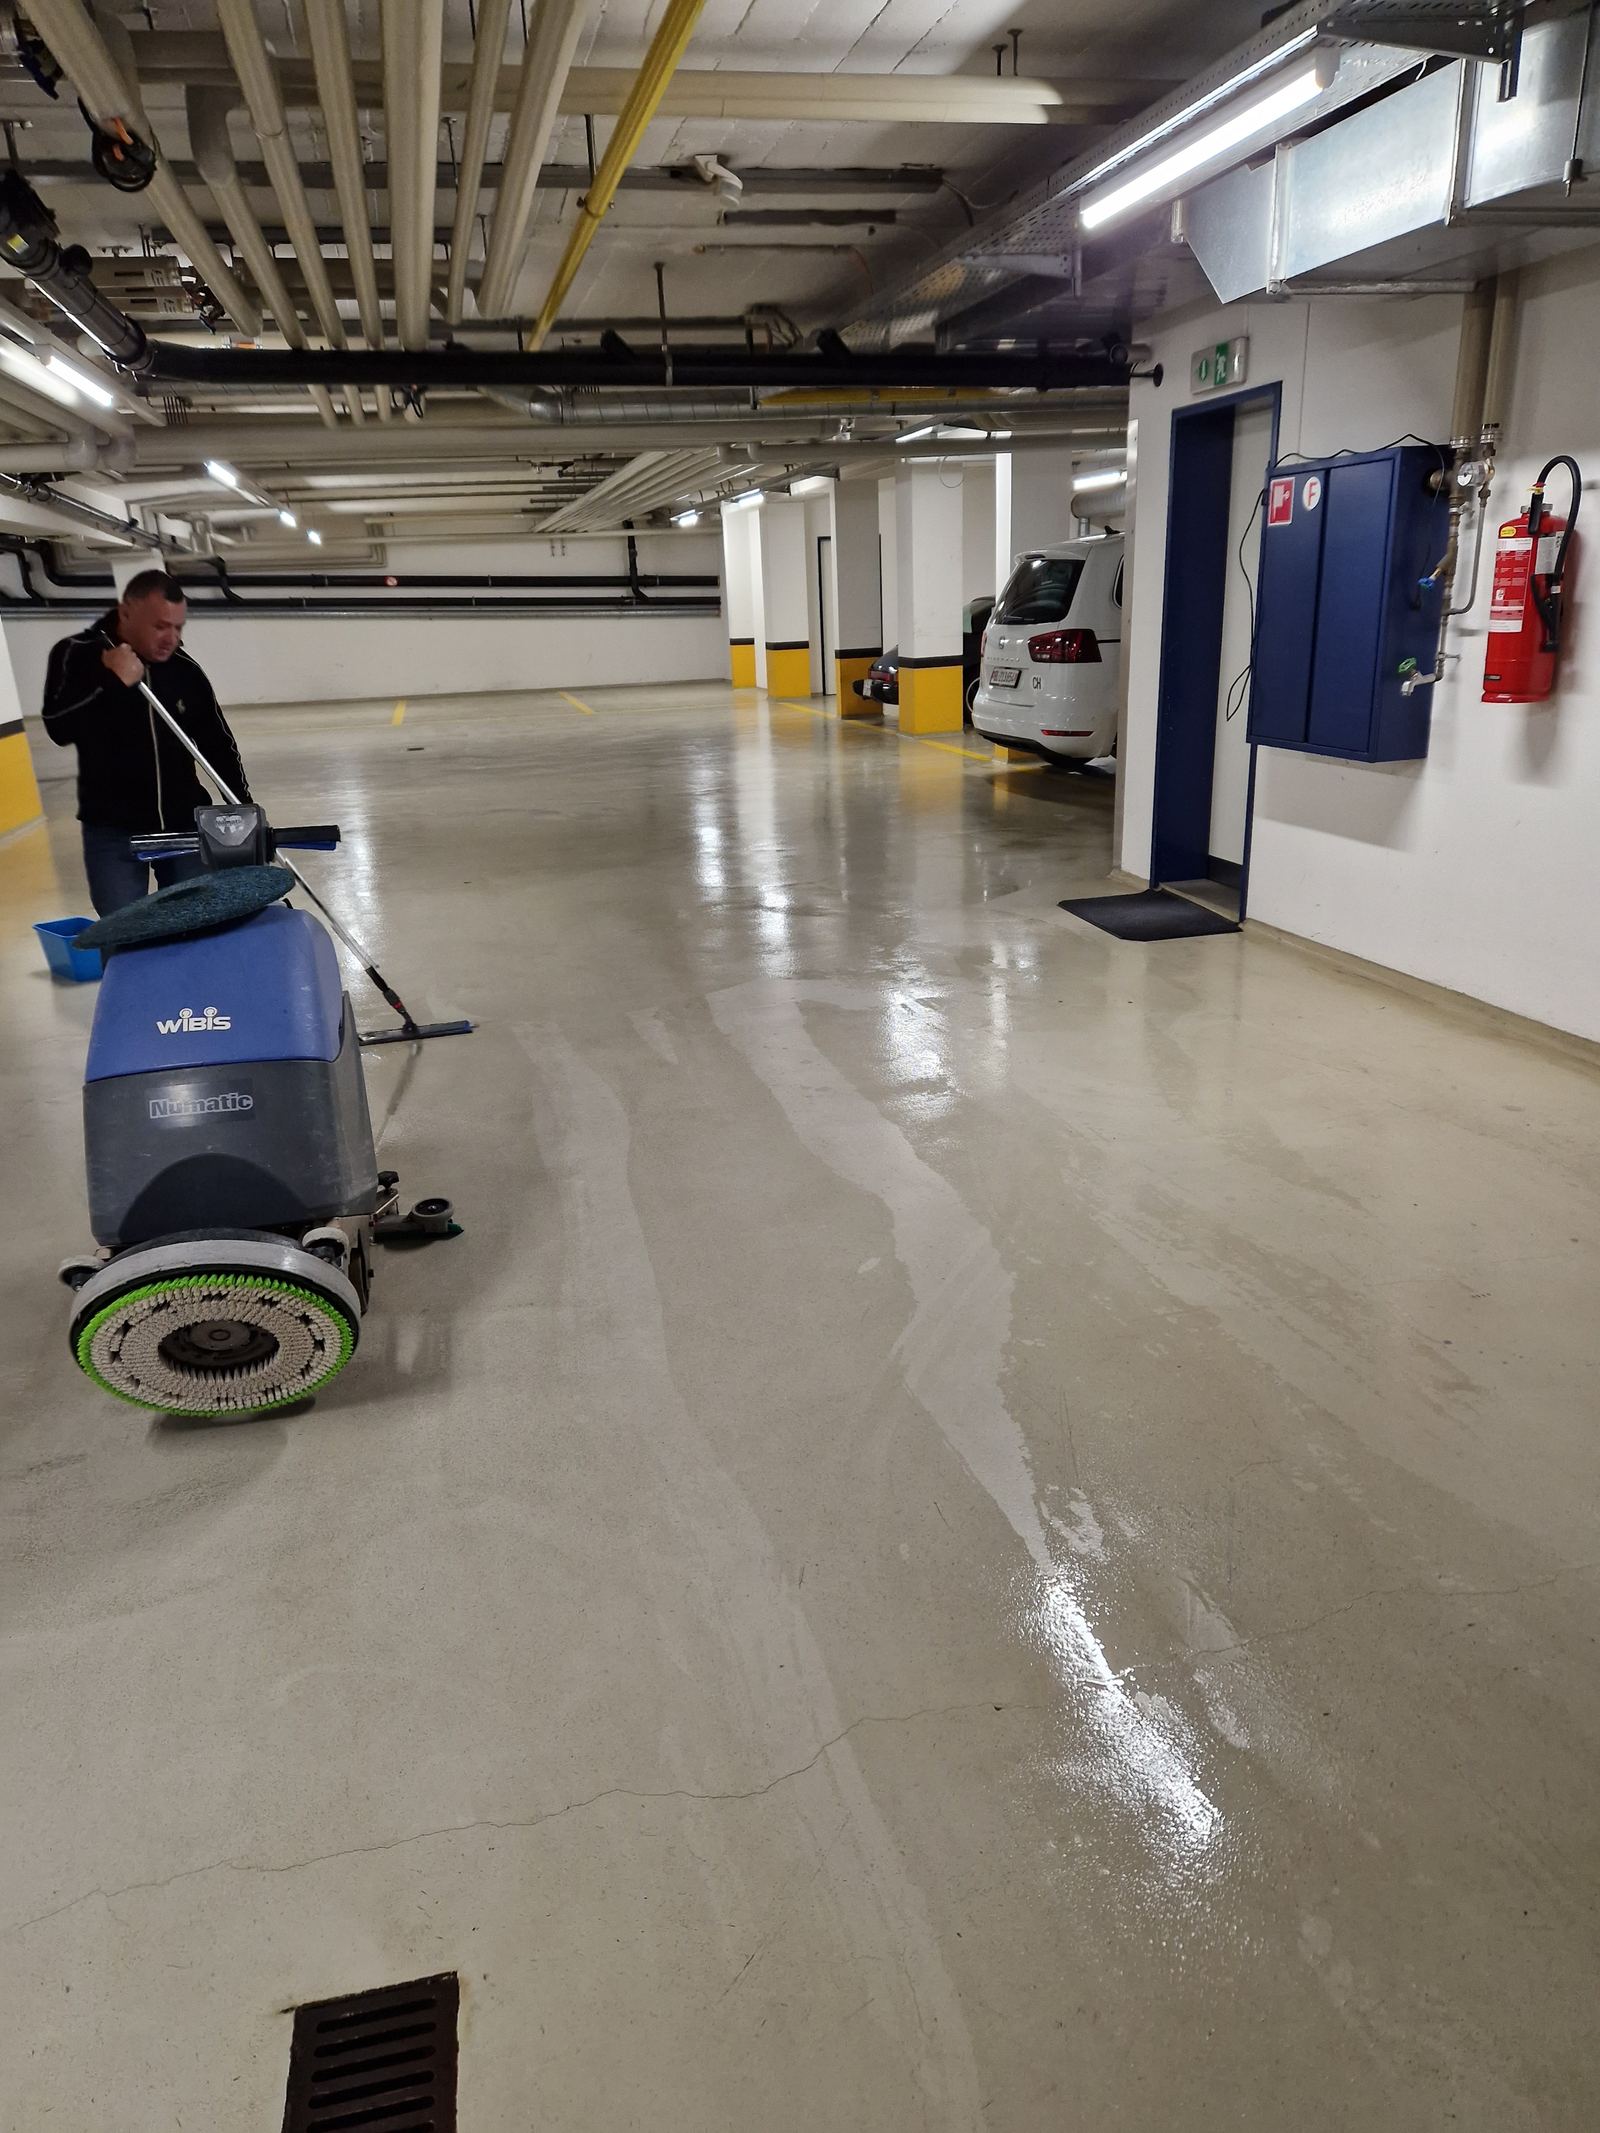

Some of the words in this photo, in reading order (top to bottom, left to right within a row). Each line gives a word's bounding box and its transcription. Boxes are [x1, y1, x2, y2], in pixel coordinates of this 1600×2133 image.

[1308, 481, 1318, 507] F
[1032, 676, 1042, 690] CH
[149, 1092, 254, 1120] Numatic
